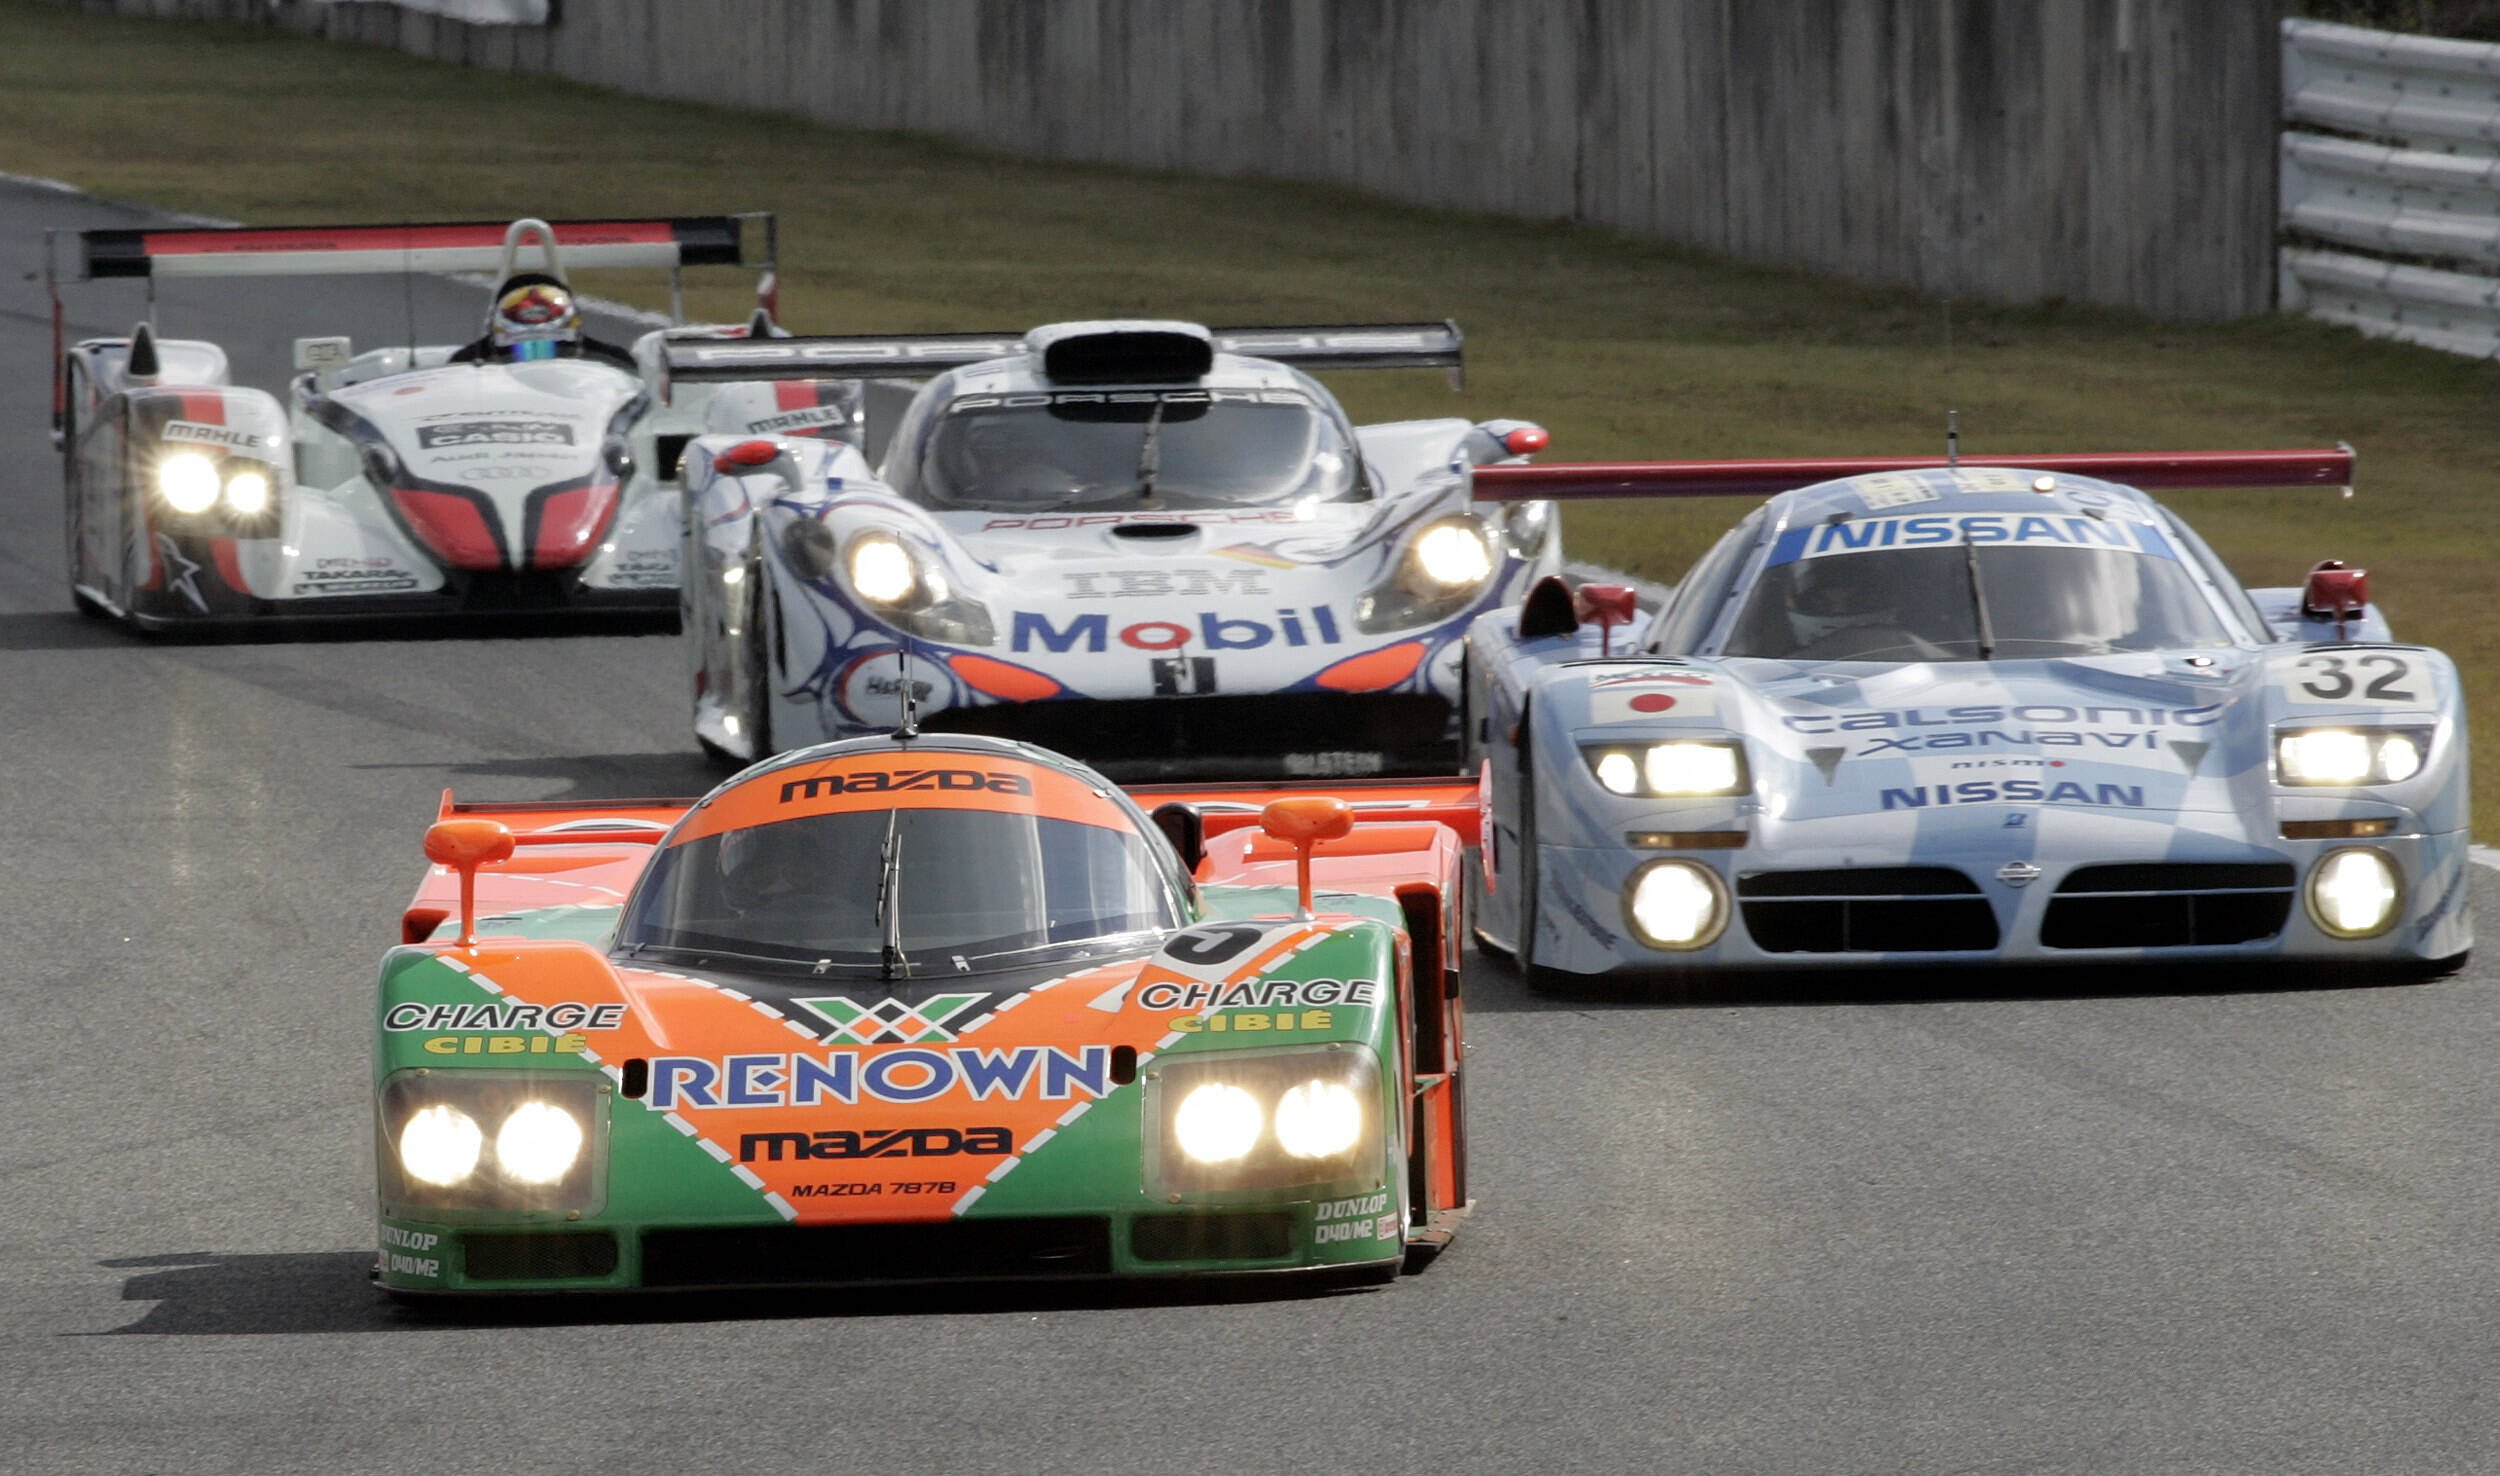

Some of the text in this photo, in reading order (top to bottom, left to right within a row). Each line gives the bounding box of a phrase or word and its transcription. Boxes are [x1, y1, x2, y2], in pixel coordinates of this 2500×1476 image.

[951, 392, 1308, 412] PORSCHE
[167, 424, 261, 447] MAHLE
[747, 408, 836, 434] MAHLE
[430, 432, 566, 446] CASIO
[983, 511, 1306, 532] PORSCHE
[1816, 516, 2130, 553] NISSAN
[1063, 569, 1271, 599] IBM
[1011, 605, 1341, 653] Mobil
[2297, 654, 2416, 702] 32
[779, 769, 1034, 804] mazda
[1879, 779, 2145, 811] NISSAN
[1137, 978, 1378, 1011] CHARGE
[385, 1002, 629, 1032] CHARGE
[646, 1045, 1112, 1111] RENOWN
[738, 1127, 1014, 1163] mazda
[792, 1181, 956, 1198] MAZDA 787B
[1315, 1193, 1388, 1221] DUNLOP
